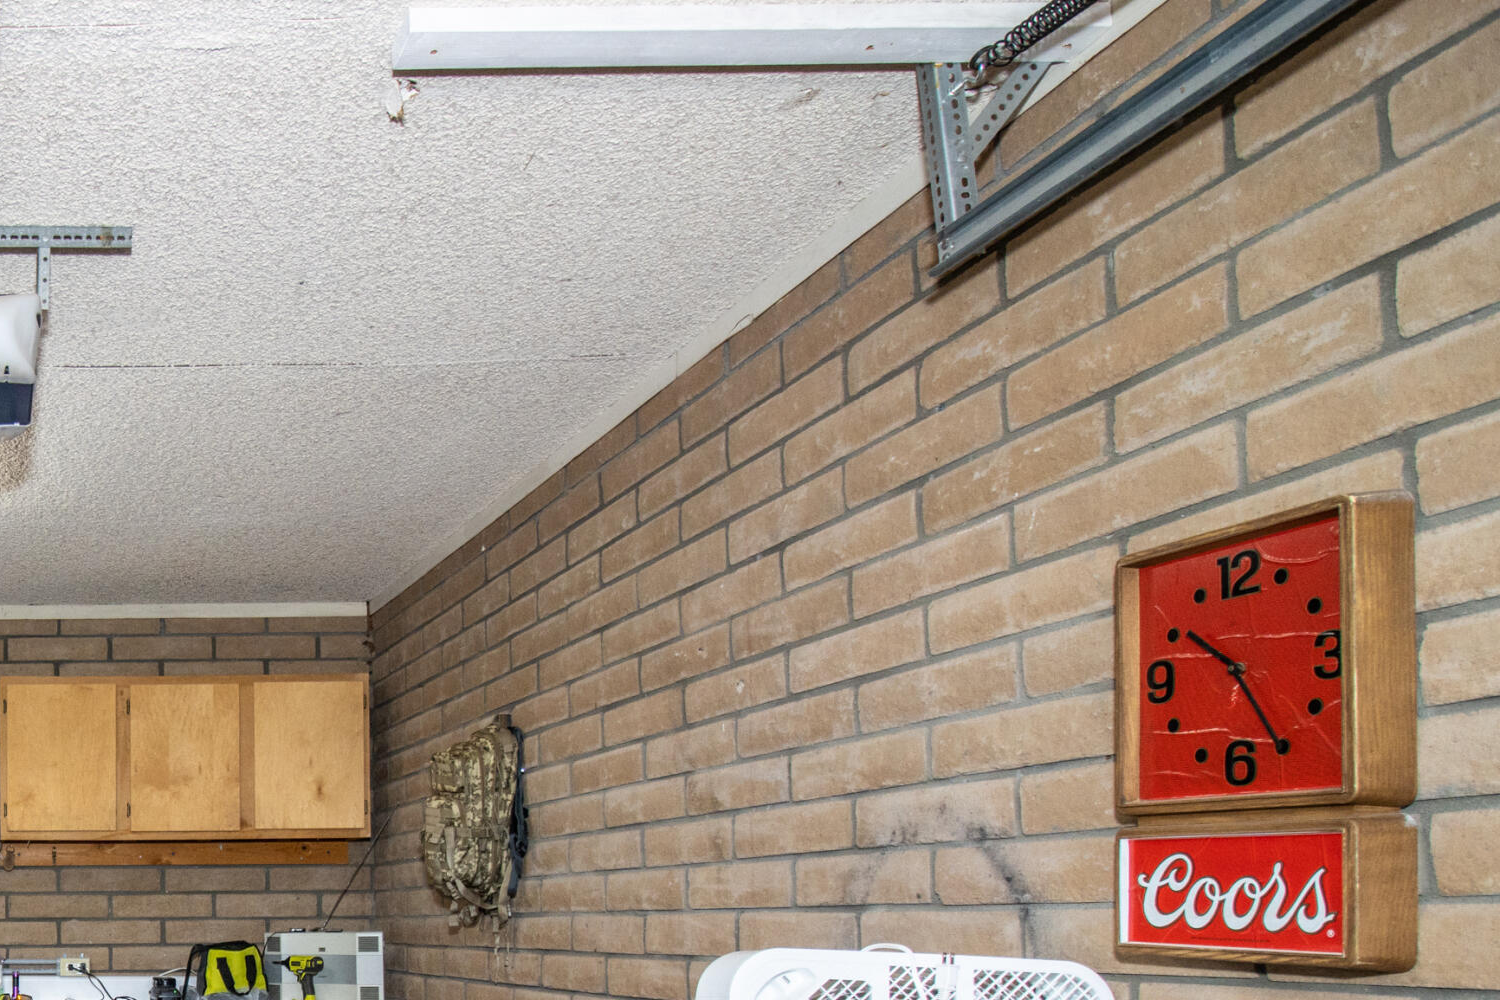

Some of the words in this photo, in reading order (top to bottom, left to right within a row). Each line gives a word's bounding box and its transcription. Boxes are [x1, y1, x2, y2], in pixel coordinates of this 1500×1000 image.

[1216, 548, 1262, 601] 12
[1313, 629, 1342, 680] 3
[1146, 659, 1176, 705] 9
[1224, 739, 1257, 787] 6
[1136, 851, 1336, 935] Coors
